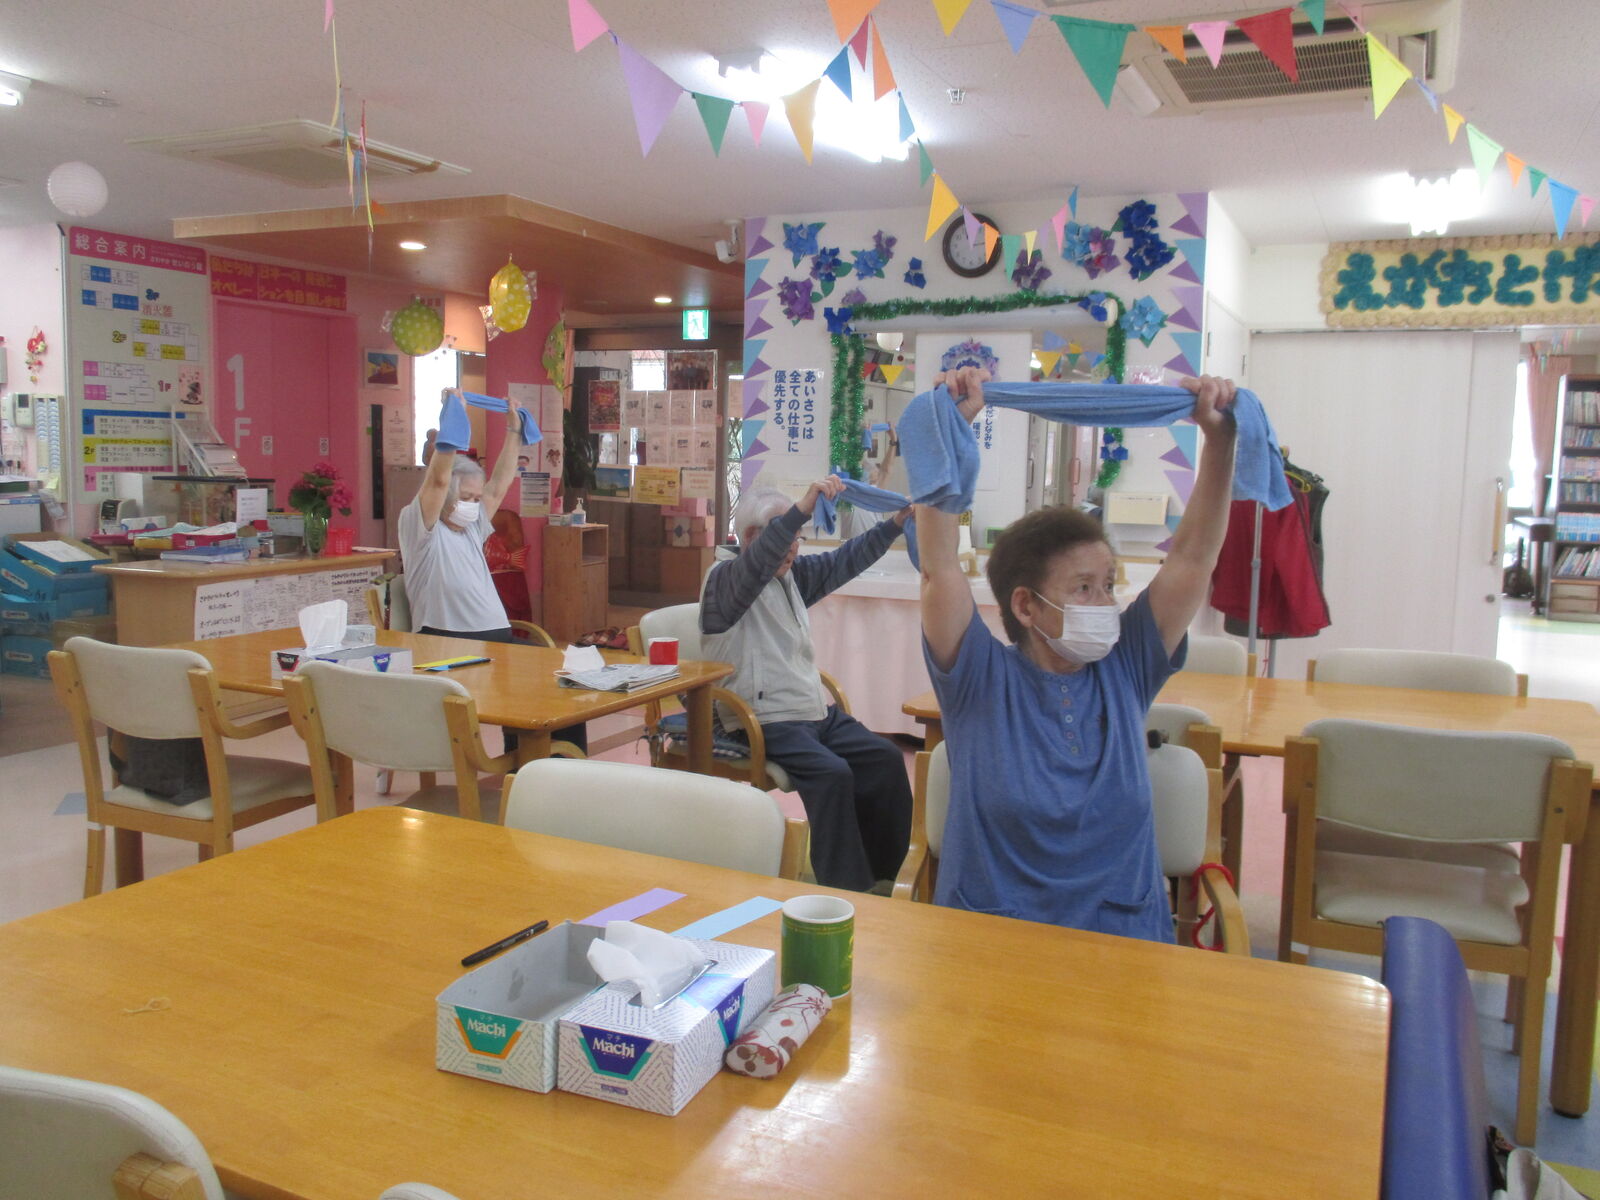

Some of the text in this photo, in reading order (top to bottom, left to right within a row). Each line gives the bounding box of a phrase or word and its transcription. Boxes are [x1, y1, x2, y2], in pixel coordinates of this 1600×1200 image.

[75, 233, 147, 260] 総合案内
[112, 330, 127, 343] 2F
[157, 380, 171, 392] 1F
[773, 370, 787, 430] 優先する。
[803, 370, 817, 440] あいさつは
[787, 370, 801, 453] 全ての仕事に
[84, 446, 95, 455] 2F
[467, 1018, 507, 1038] Machi
[592, 1037, 635, 1059] Machi
